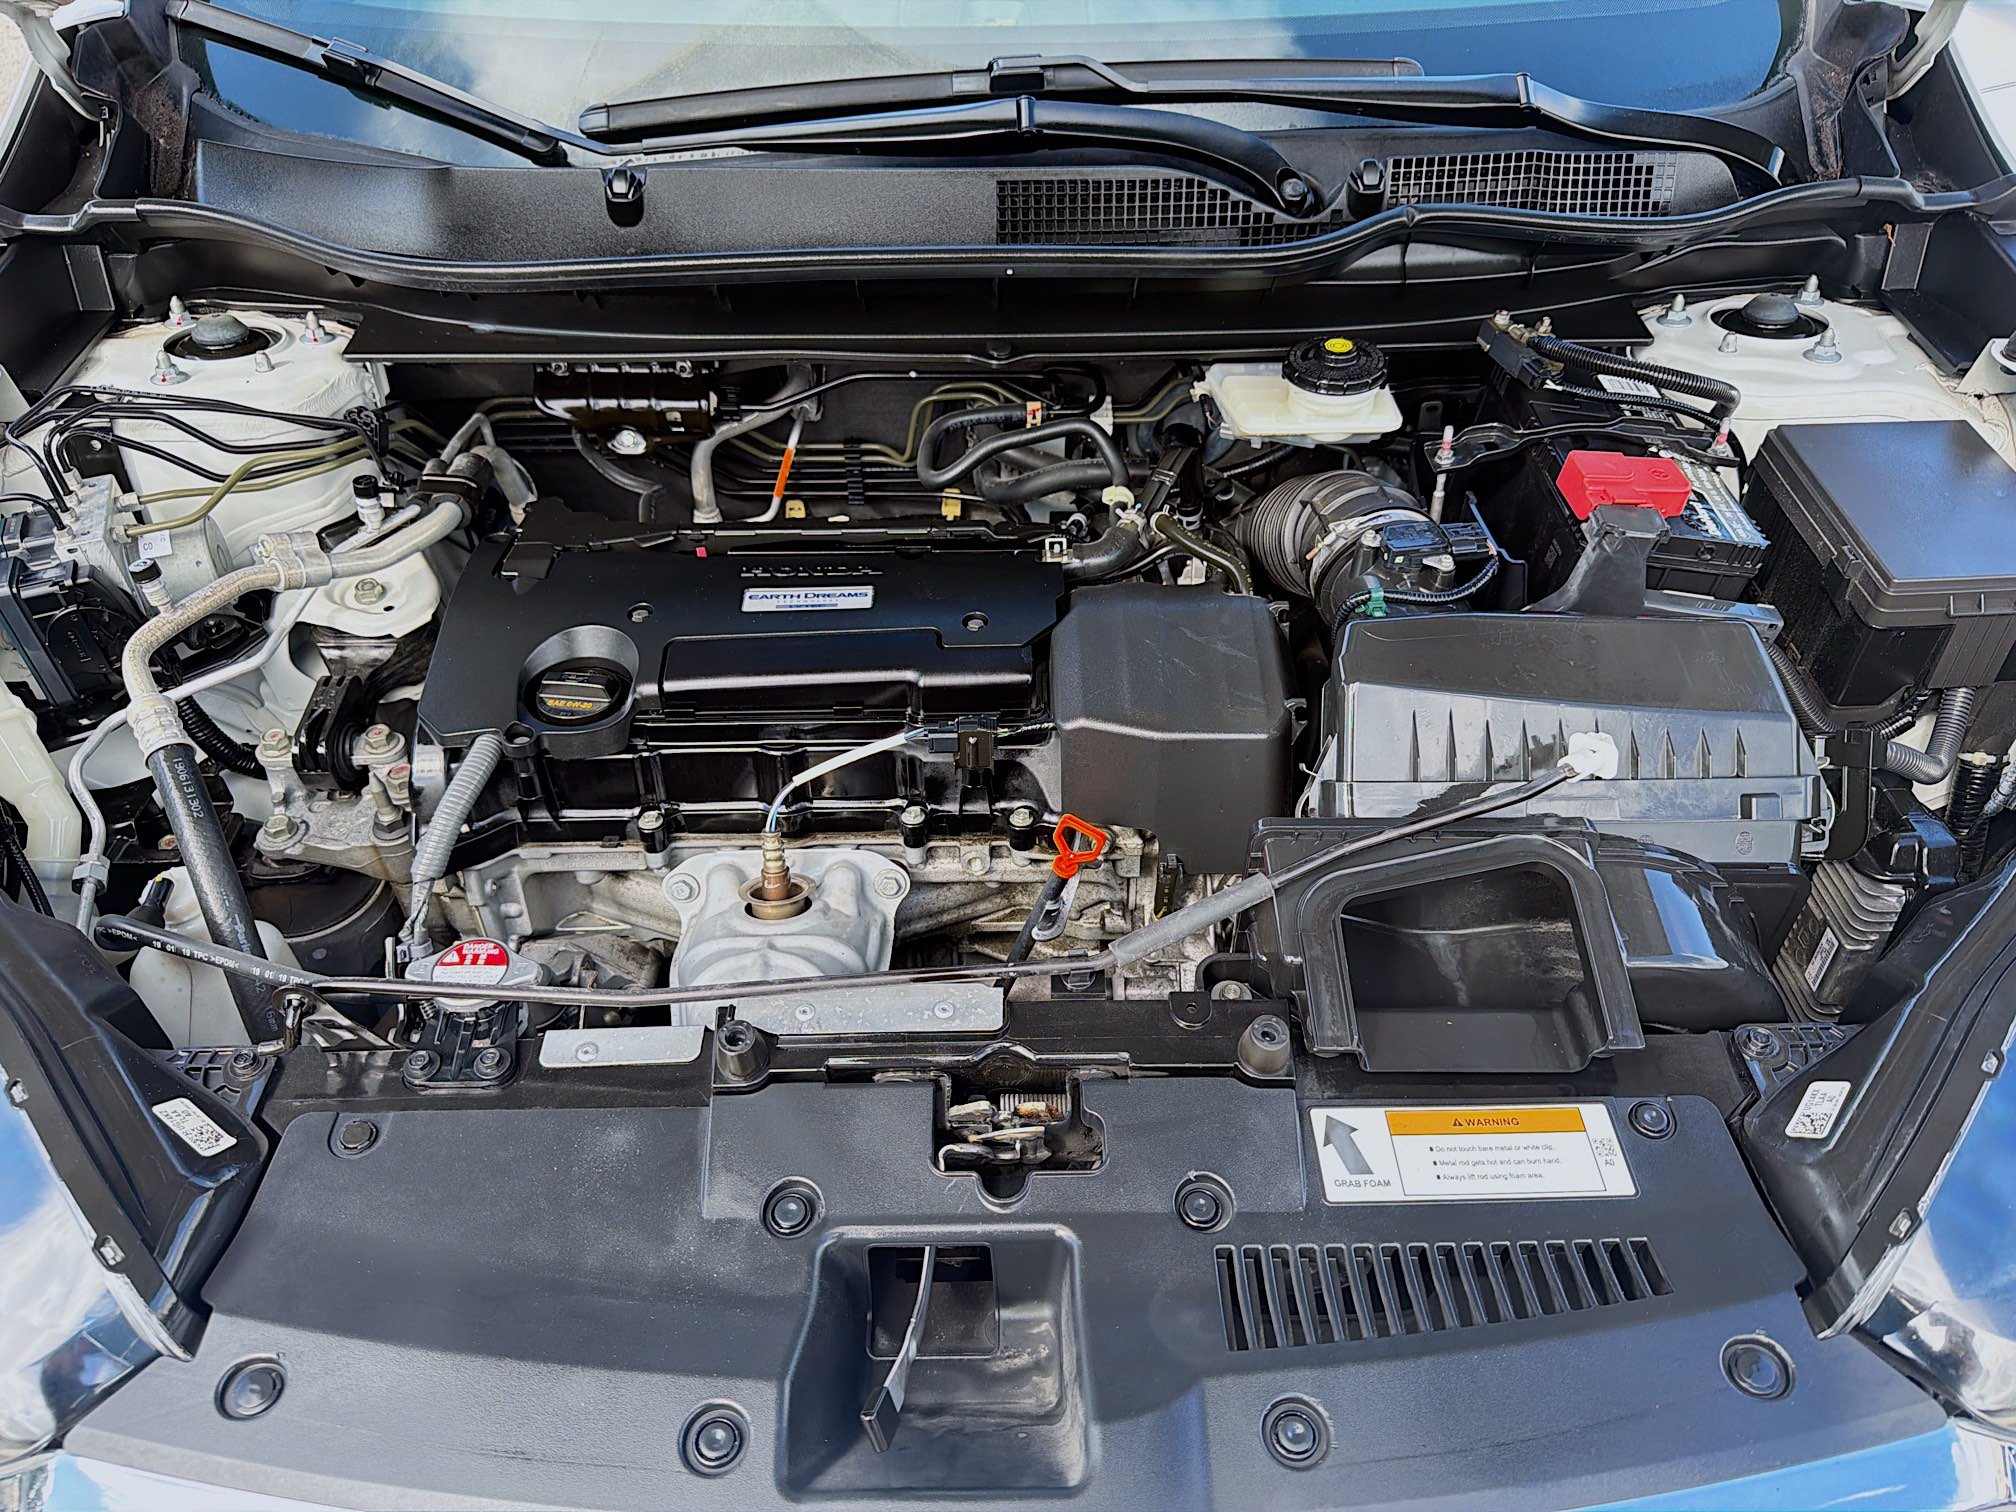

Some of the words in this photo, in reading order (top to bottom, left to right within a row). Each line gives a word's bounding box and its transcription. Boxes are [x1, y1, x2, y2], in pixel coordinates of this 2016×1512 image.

[741, 566, 884, 577] HONDA
[547, 699, 565, 708] SAE
[566, 700, 593, 709] 0W-20
[172, 756, 205, 819] 1906131302
[193, 950, 209, 961] TPC
[210, 955, 240, 969] >EPDM<
[1464, 1117, 1520, 1127] WARNING
[1495, 1144, 1512, 1152] metal
[1471, 1159, 1486, 1168] gets
[1526, 1157, 1541, 1165] burn
[1443, 1174, 1466, 1182] Always
[1490, 1173, 1508, 1181] using
[1334, 1179, 1362, 1188] GRAB
[1363, 1178, 1391, 1188] FOAM
